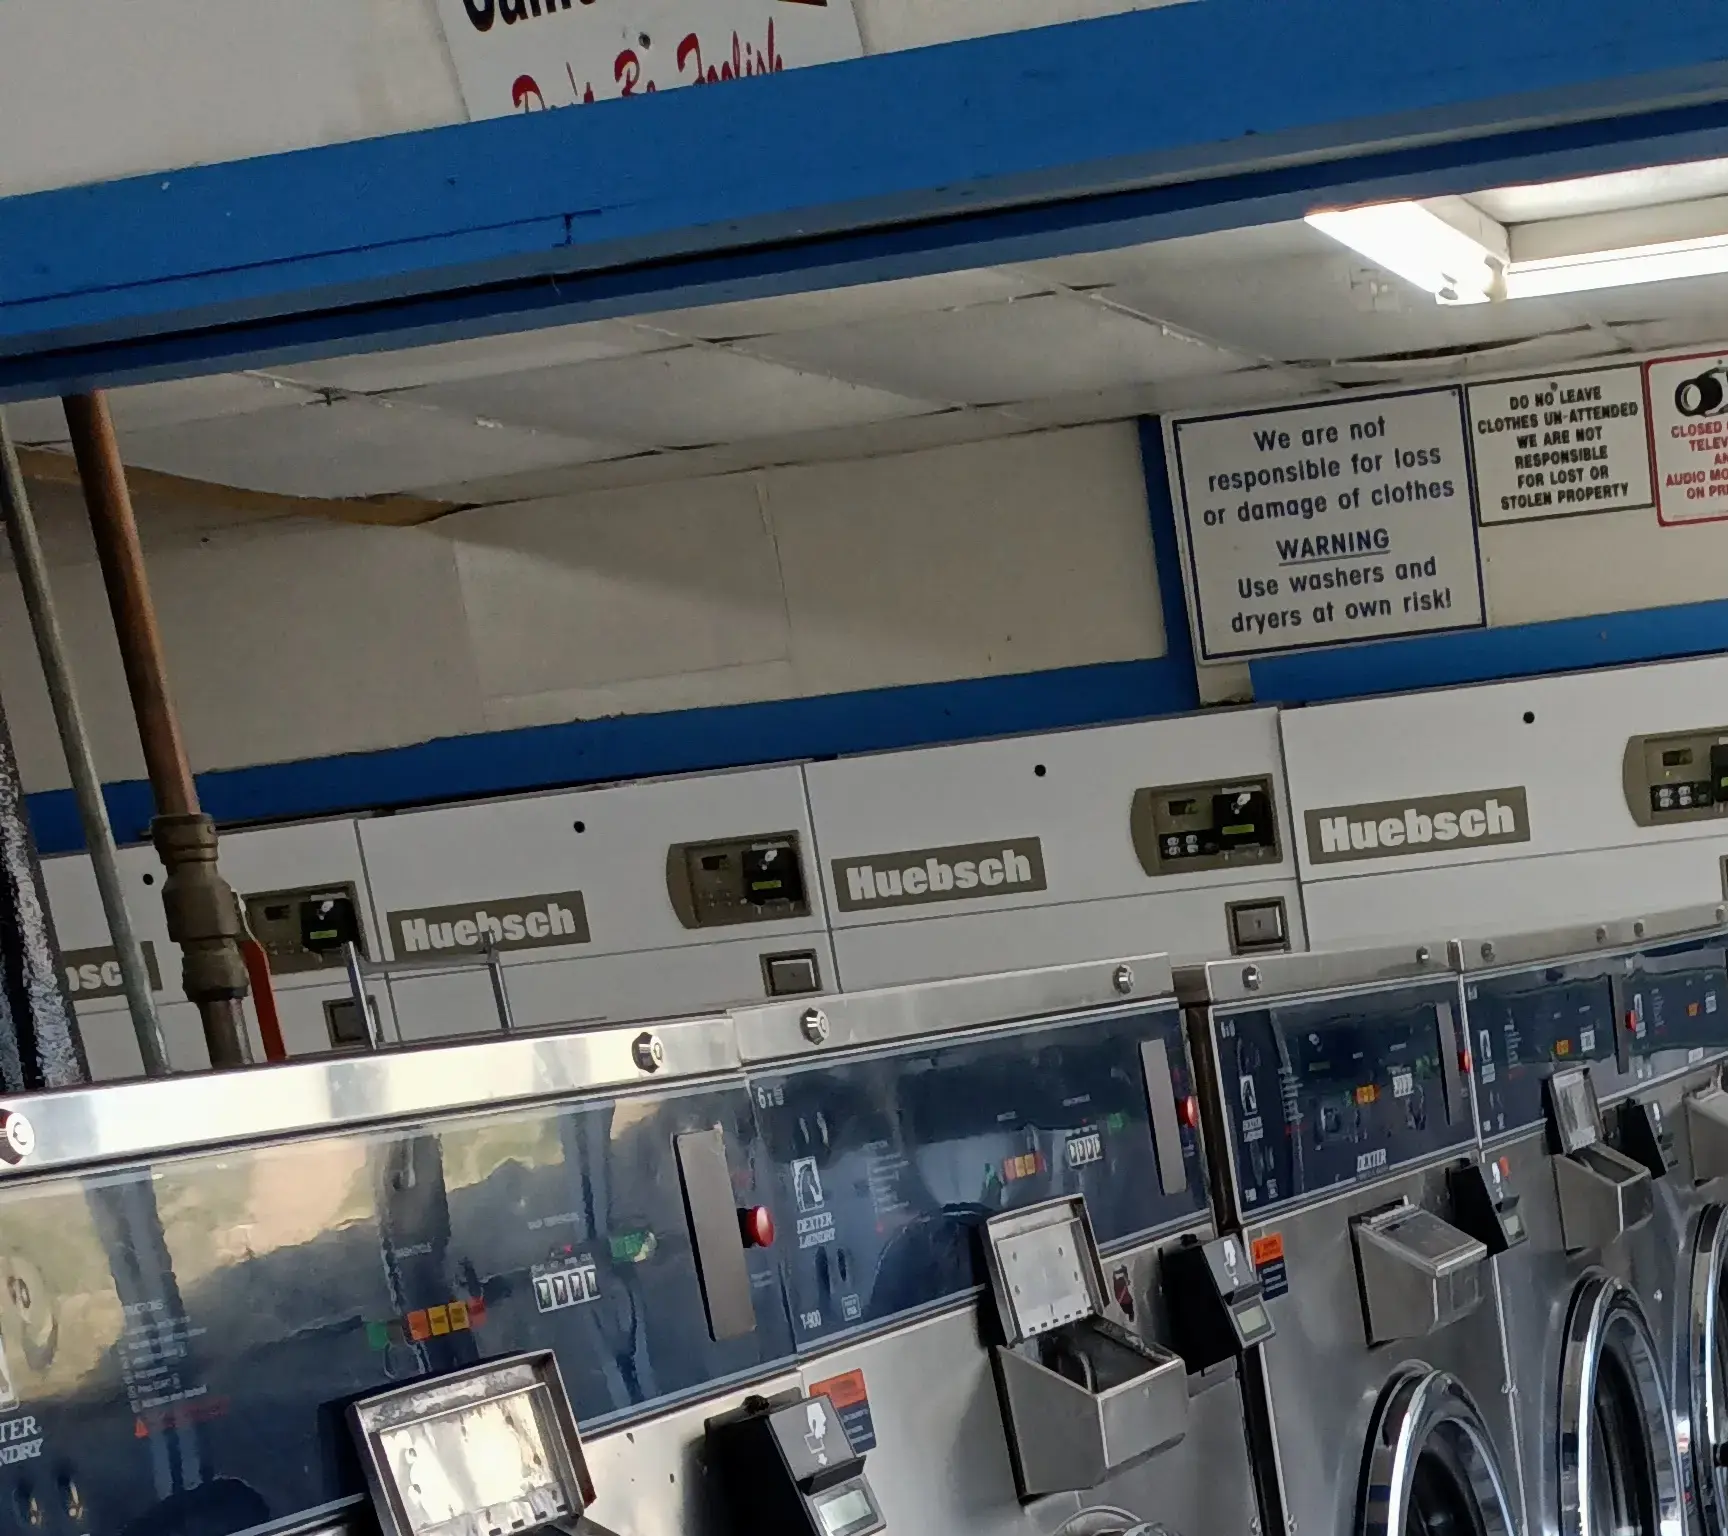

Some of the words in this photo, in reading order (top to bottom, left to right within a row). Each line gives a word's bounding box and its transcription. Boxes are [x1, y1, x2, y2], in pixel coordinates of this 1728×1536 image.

[1510, 395, 1529, 410] DO
[1535, 391, 1554, 407] NO
[1560, 385, 1602, 404] LEAVE
[1254, 430, 1291, 451] We
[1302, 426, 1339, 447] are
[1350, 416, 1386, 440] not
[1477, 413, 1539, 434] CLOTHES
[1544, 401, 1638, 426] UN-ATTENDED
[1671, 421, 1723, 438] CLOSED
[1516, 434, 1537, 449] WE
[1544, 430, 1570, 446] ARE
[1575, 425, 1603, 442] NOT
[1208, 457, 1340, 492] responsible
[1352, 452, 1383, 474] for
[1395, 447, 1441, 469] loss
[1515, 445, 1608, 470] RESPONSIBLE
[1517, 472, 1544, 489] FOR
[1550, 467, 1584, 485] LOST
[1590, 465, 1609, 480] OR
[1666, 470, 1706, 488] AUDIO
[1686, 486, 1705, 500] ON
[1203, 507, 1226, 526] or
[1237, 495, 1328, 520] damage
[1338, 487, 1361, 510] of
[1371, 480, 1455, 506] clothes
[1501, 491, 1552, 511] STOLEN
[1558, 482, 1629, 504] PROPERTY
[1275, 528, 1391, 561] WARNING
[1238, 577, 1279, 599] Use
[1290, 565, 1384, 593] washers
[1395, 556, 1437, 580] and
[1232, 606, 1302, 634] dryers
[1312, 601, 1334, 624] at
[1345, 597, 1392, 619] own
[1403, 587, 1452, 613] risk!
[1319, 799, 1516, 853] Huebsch
[846, 850, 1031, 901] Huebsch
[401, 903, 575, 952] Huebsch
[797, 1211, 832, 1234] DEXTER
